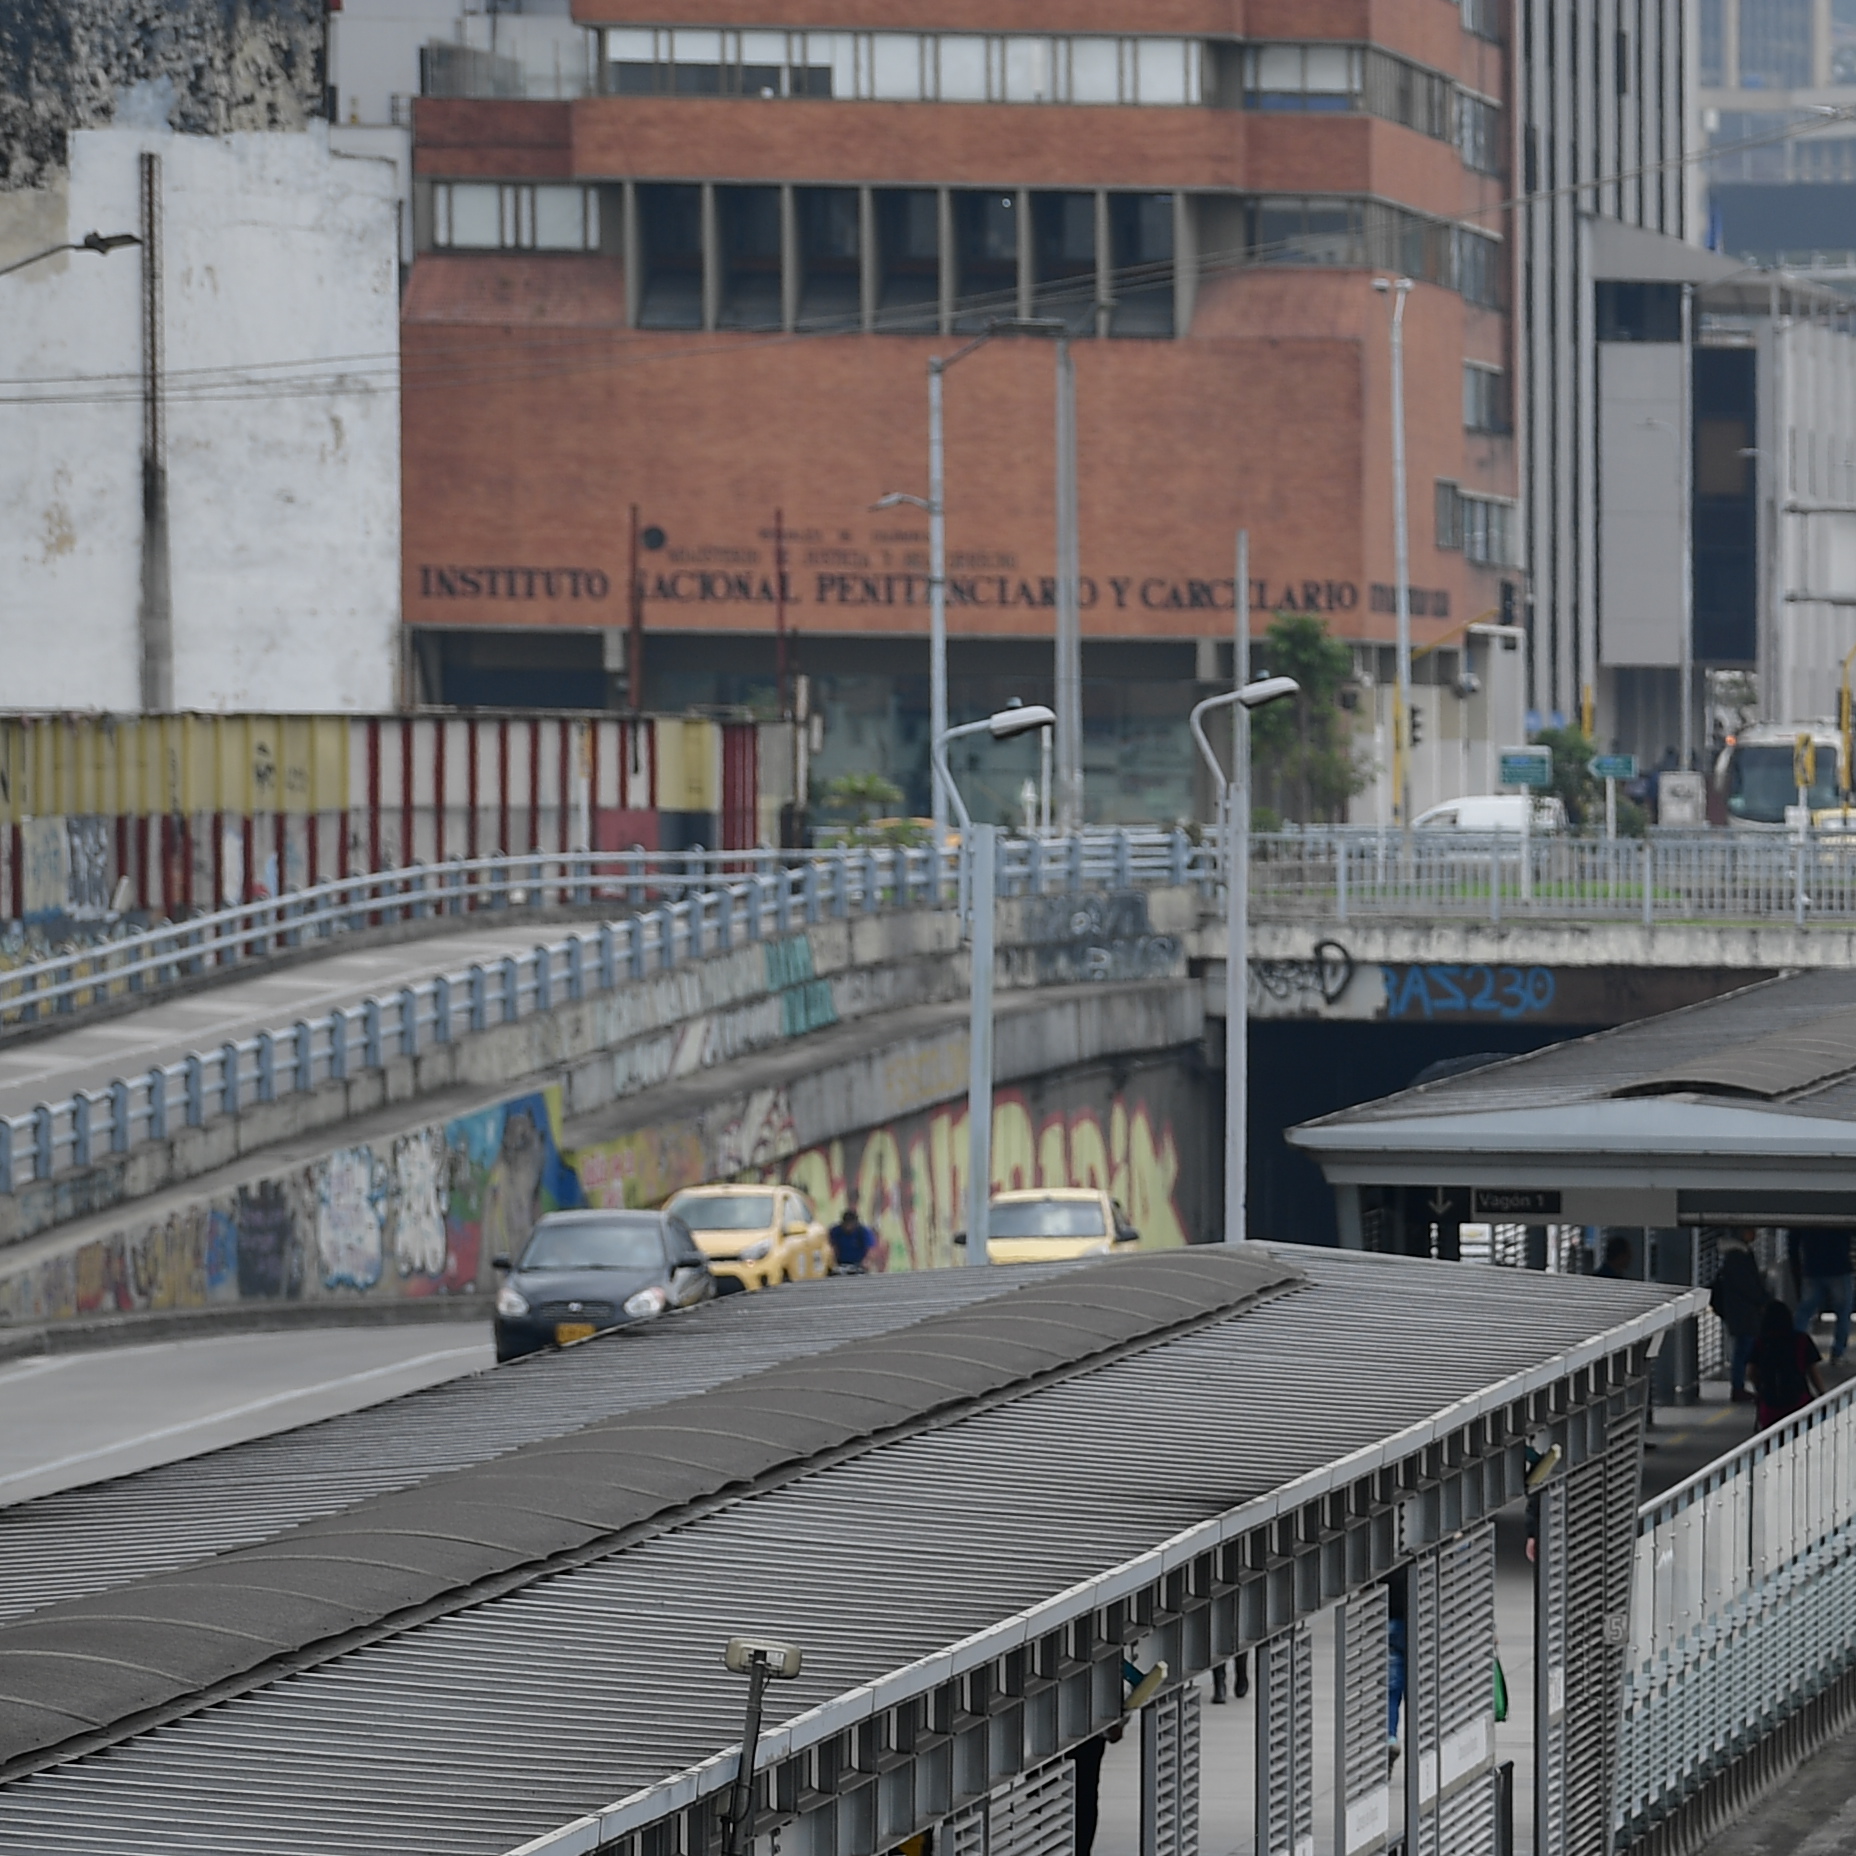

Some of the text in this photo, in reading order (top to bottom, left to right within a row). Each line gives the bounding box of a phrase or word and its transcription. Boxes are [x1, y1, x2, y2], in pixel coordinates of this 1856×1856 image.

[419, 564, 609, 599] INSTITUTO
[1108, 575, 1134, 609] Y
[1478, 1192, 1531, 1209] Vagón
